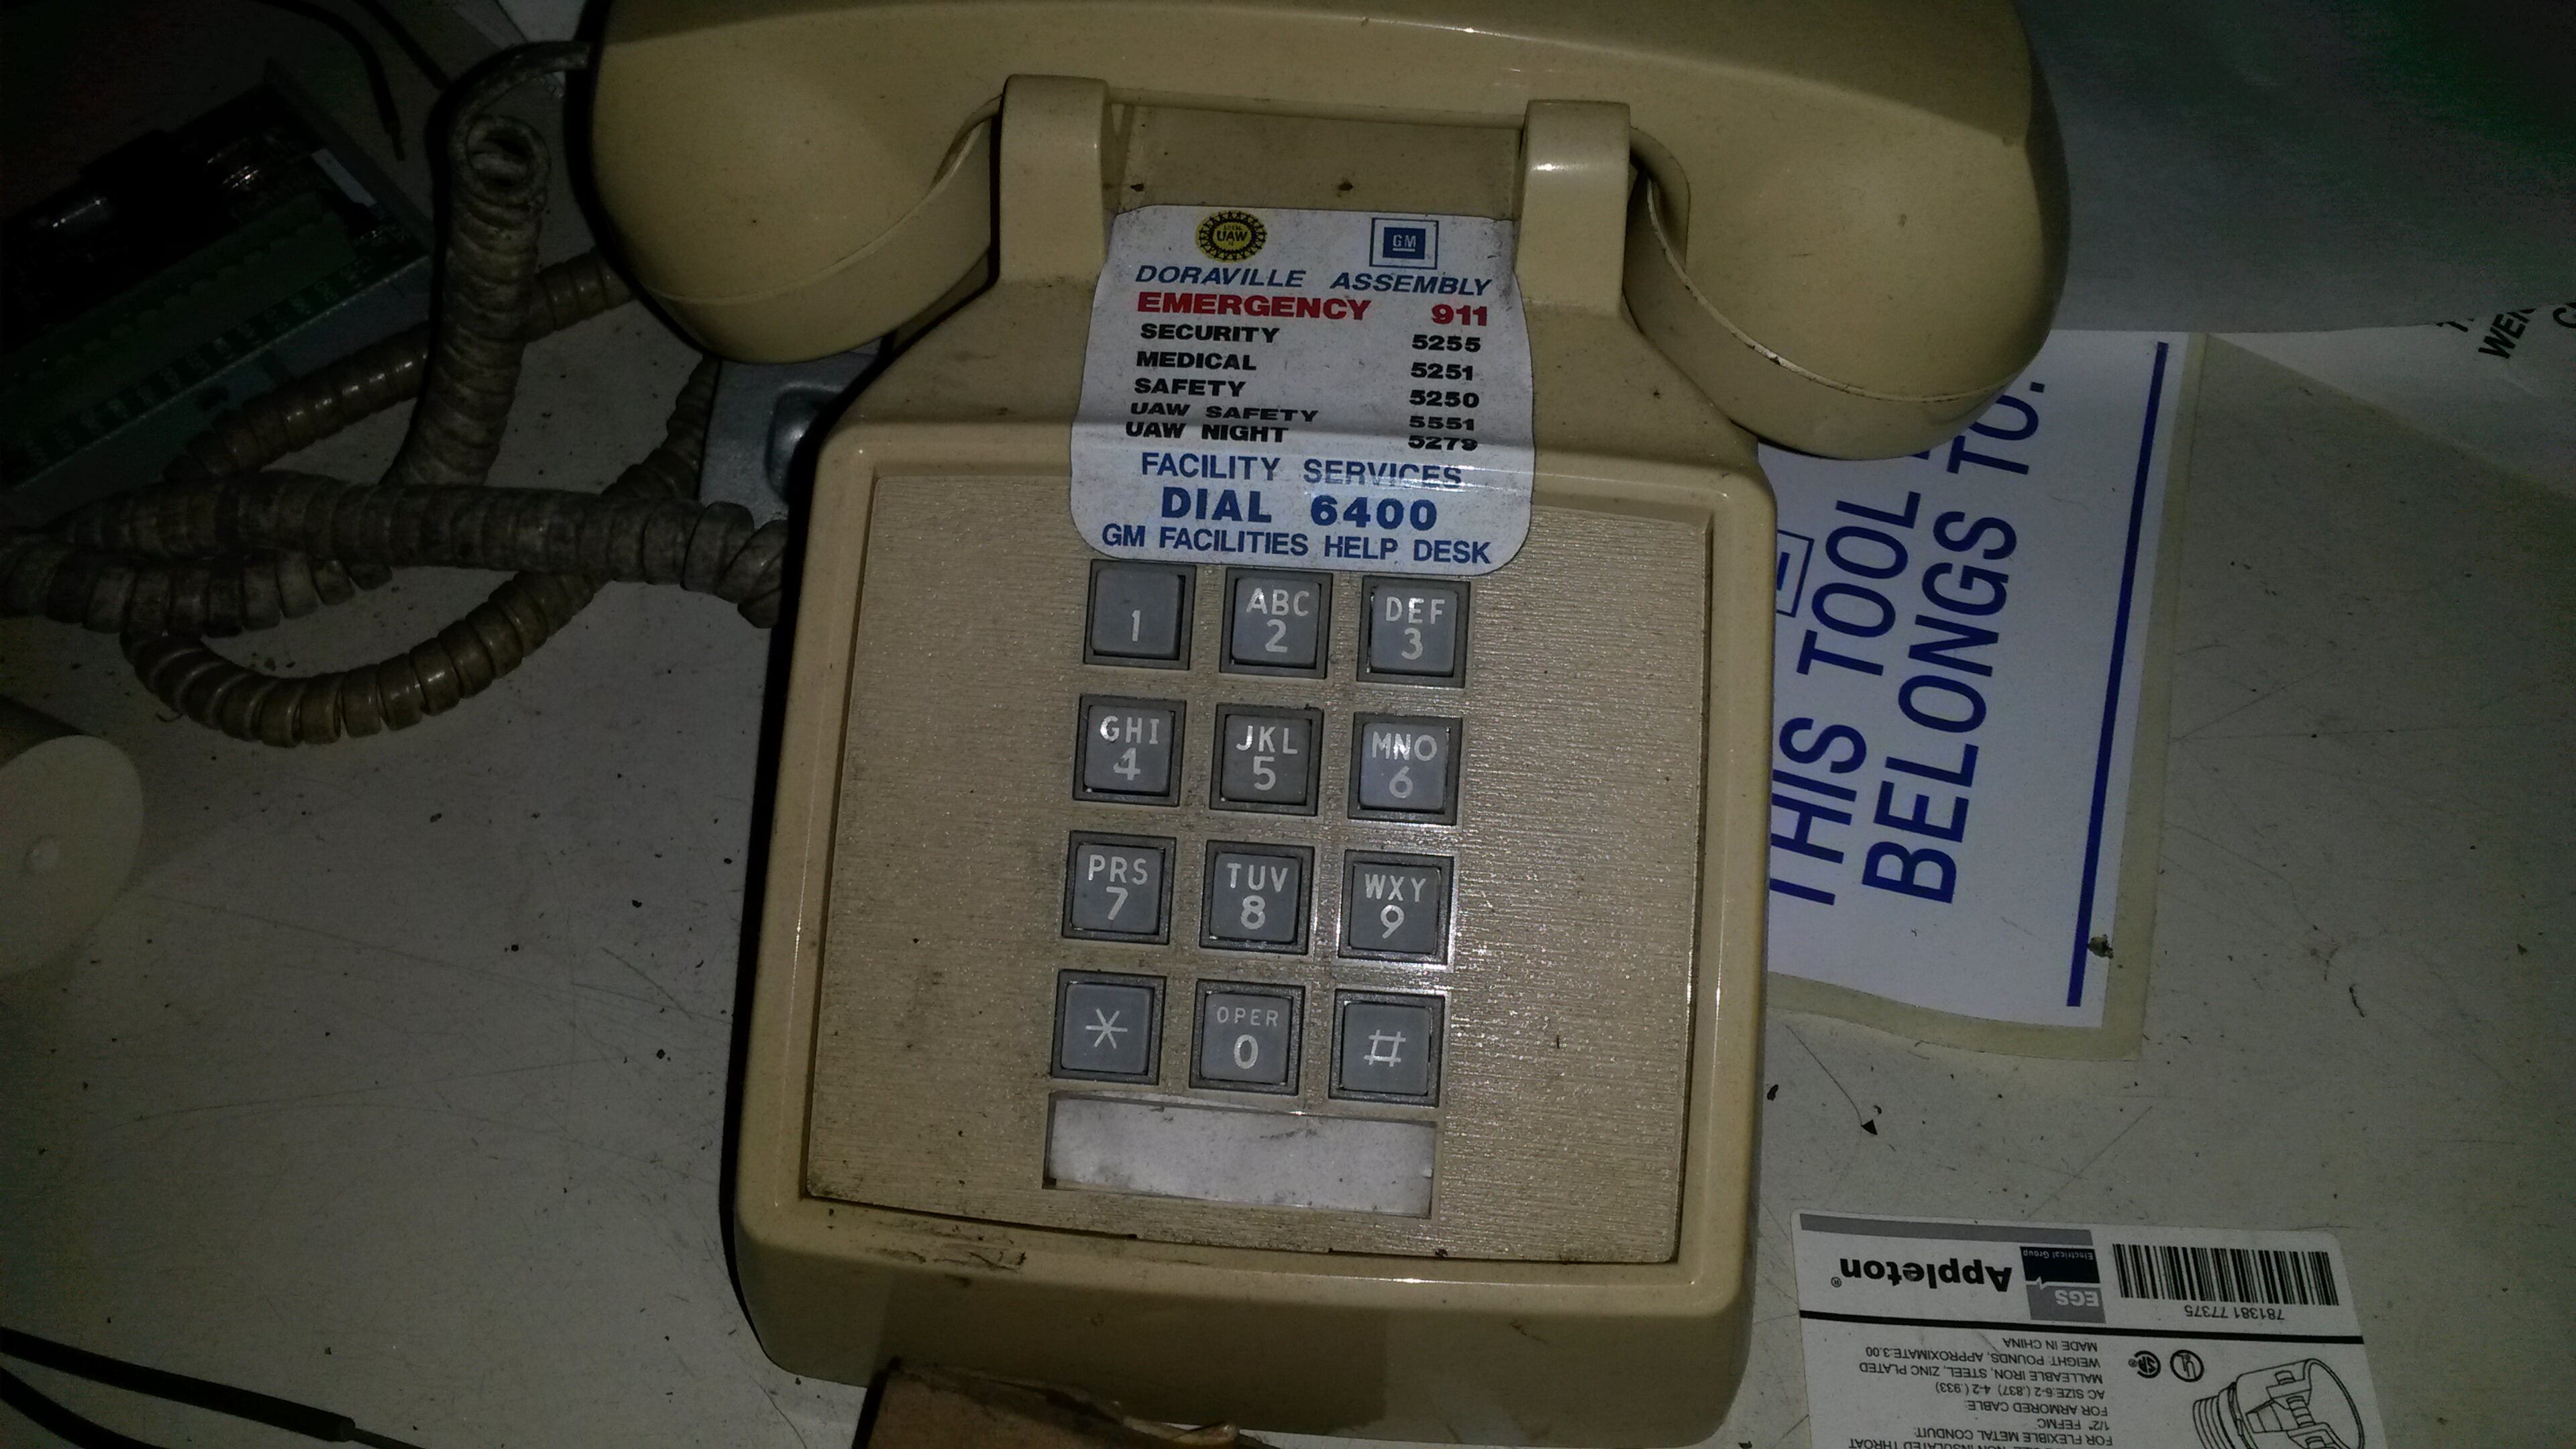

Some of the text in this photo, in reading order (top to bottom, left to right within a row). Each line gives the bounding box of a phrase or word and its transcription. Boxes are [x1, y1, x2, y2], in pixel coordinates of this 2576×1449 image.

[1217, 230, 1248, 241] UAW
[1391, 233, 1417, 249] GM
[1135, 265, 1493, 297] DORAVILLE ASSEMBLY
[1138, 291, 1487, 326] EMERGENCY 911
[1140, 323, 1481, 353] SECURITY 5255
[1136, 351, 1474, 381] MEDICAL 5251
[1134, 378, 1480, 409] SAFETY 5250
[1131, 402, 1474, 431] UAW SAFETY 5551
[1126, 422, 1185, 439] UAW
[1201, 425, 1289, 443] NIGHT
[1141, 452, 1461, 489] FACILITY SERVICES
[1161, 487, 1437, 531] DIAL 6400
[1102, 523, 1491, 564] GM FACILITIES HELP DESK
[1796, 491, 1921, 676] TOOL
[1246, 587, 1310, 617] ABC
[1385, 596, 1446, 625] DEF
[1131, 610, 1140, 642] 1
[1265, 619, 1288, 653] 2
[1401, 627, 1424, 660] 3
[1862, 511, 2017, 904] BELONGS
[1099, 715, 1160, 745] GHI
[1235, 724, 1299, 755] JKL
[1371, 732, 1438, 761] MNO
[1113, 747, 1141, 782] 4
[1253, 757, 1276, 791] 5
[1389, 766, 1413, 799] 6
[1088, 854, 1148, 885] PRS
[1226, 863, 1289, 893] TUV
[1364, 873, 1426, 903] WXY
[1106, 887, 1128, 921] 7
[1240, 896, 1266, 930] 8
[1380, 905, 1405, 938] 9
[1216, 1006, 1279, 1028] OPER
[2022, 1249, 2094, 1261] Electrical Group
[2055, 1289, 2100, 1307] EGS
[2184, 1305, 2284, 1320] 781381 77375
[1987, 1353, 2043, 1364] POUNDS,
[2003, 1338, 2096, 1351] MADE IN CHINA
[1860, 1363, 1906, 1373] PLATED
[1911, 1366, 1939, 1375] ZINC
[2029, 1372, 2102, 1383] MALLEABLE
[1972, 1385, 1990, 1393] 4-2
[2088, 1390, 2104, 1398] AC
[2012, 1403, 2077, 1413] ARMORED
[2080, 1406, 2107, 1415] FOR
[1978, 1431, 2018, 1440] METAL
[2023, 1433, 2081, 1444] FLEXIBLE
[2037, 1419, 2080, 1428] FEFMC
[1848, 1438, 1898, 1449] THROAT
[2085, 1435, 2112, 1444] FOR
